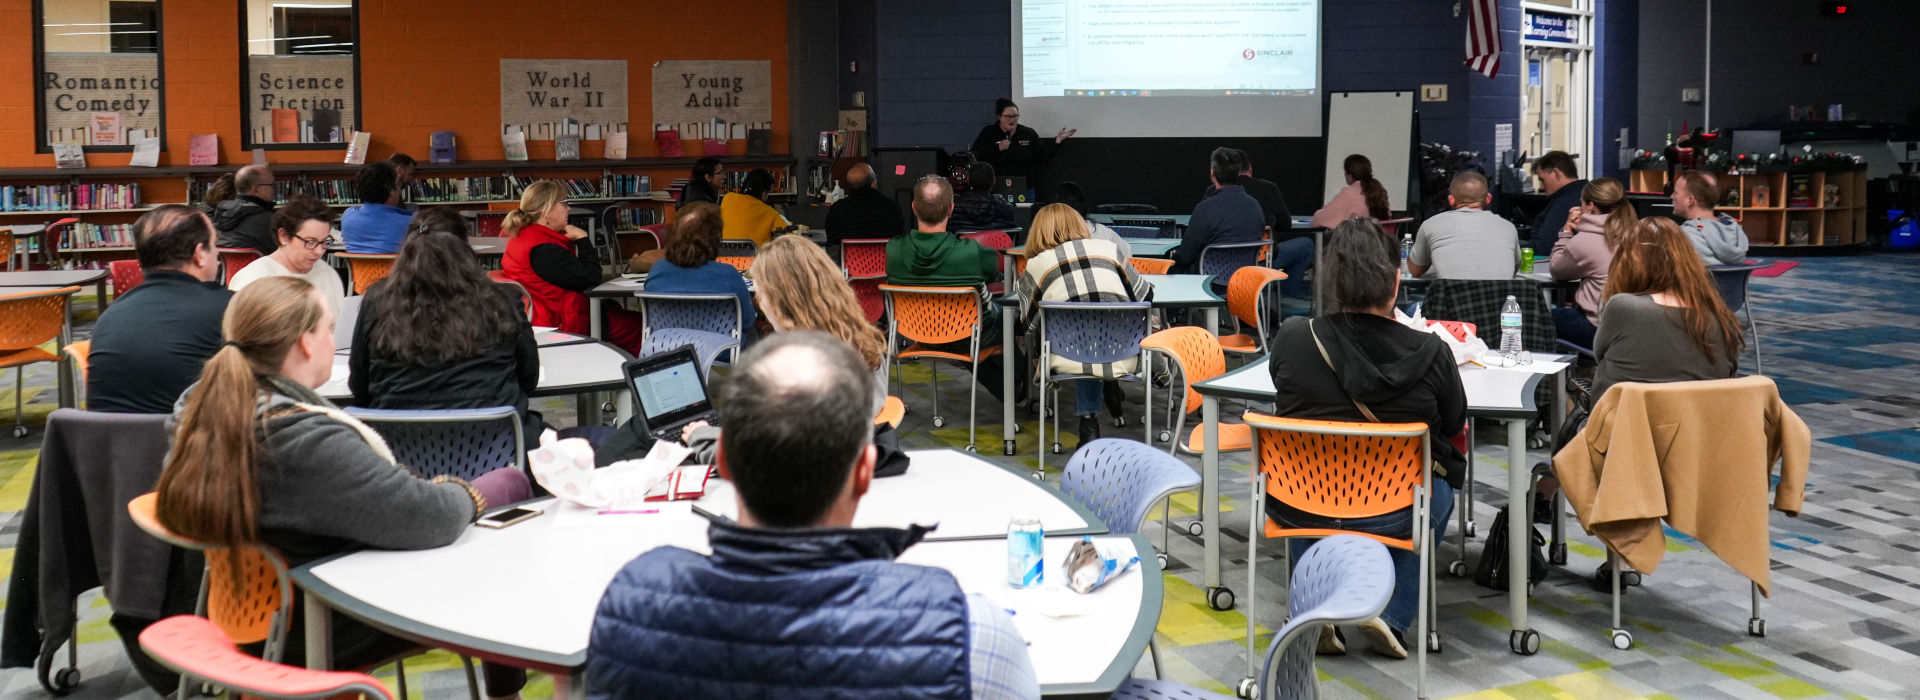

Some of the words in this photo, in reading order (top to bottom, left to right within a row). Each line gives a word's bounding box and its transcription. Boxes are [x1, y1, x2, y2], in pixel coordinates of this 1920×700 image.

[1536, 15, 1552, 25] Welcome
[1531, 26, 1549, 39] Learning
[45, 72, 159, 90] Romantic
[260, 72, 344, 90] Science
[527, 71, 591, 88] World
[681, 73, 743, 93] Young
[55, 94, 150, 116] Comedy
[260, 94, 345, 111] Fiction
[526, 91, 570, 108] War
[584, 92, 604, 107] II
[685, 91, 740, 108] Adult
